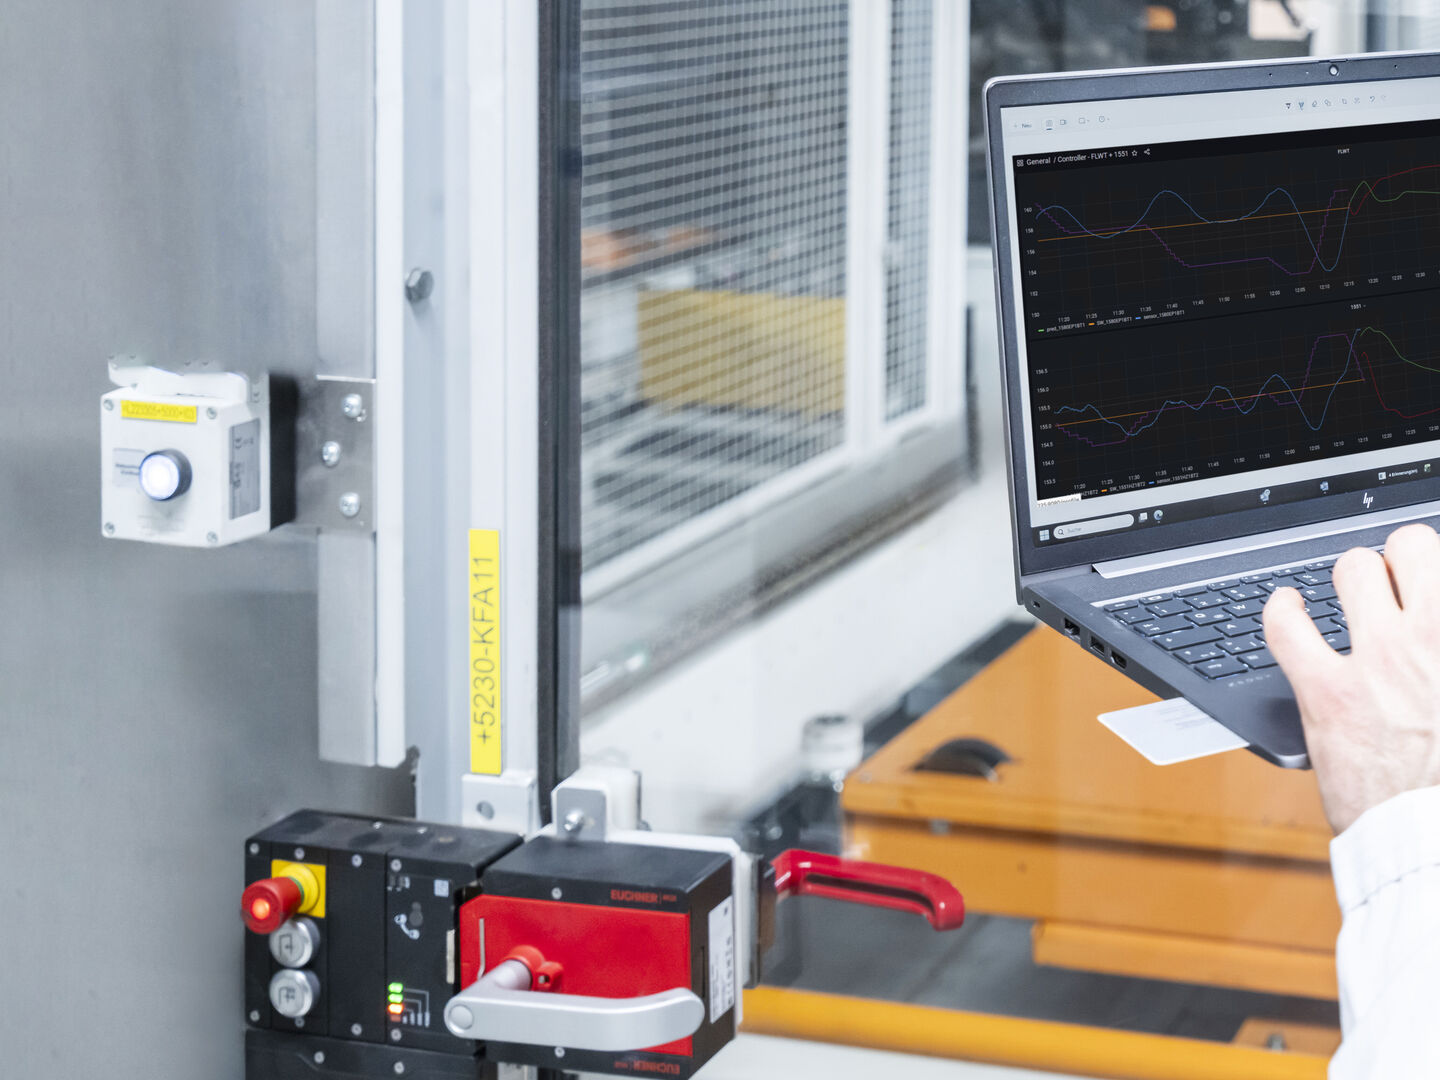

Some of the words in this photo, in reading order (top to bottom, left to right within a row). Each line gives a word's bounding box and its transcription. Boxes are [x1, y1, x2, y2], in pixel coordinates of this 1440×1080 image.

[1026, 157, 1051, 166] General
[1057, 154, 1086, 163] Controller
[1091, 152, 1107, 160] FLWT
[1114, 150, 1128, 158] 1551
[1362, 492, 1374, 509] hp
[472, 558, 495, 744] +5230-KFA11
